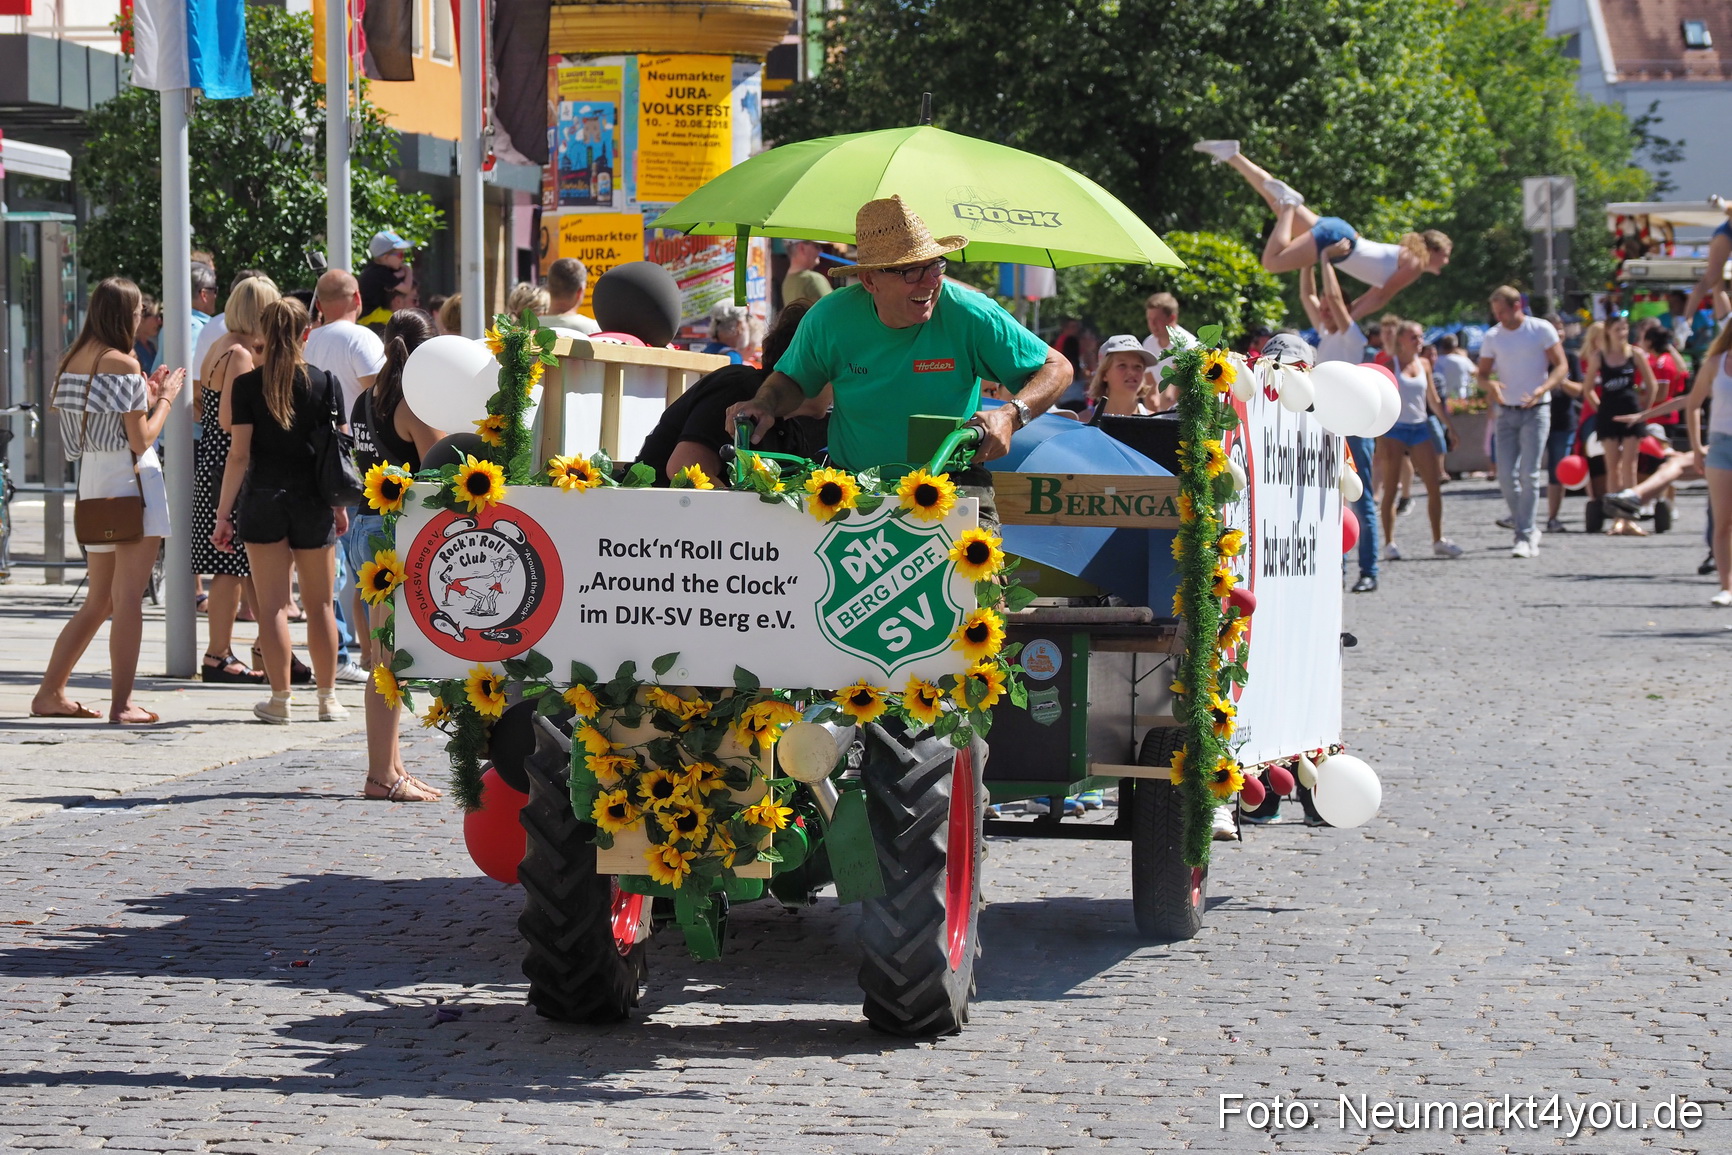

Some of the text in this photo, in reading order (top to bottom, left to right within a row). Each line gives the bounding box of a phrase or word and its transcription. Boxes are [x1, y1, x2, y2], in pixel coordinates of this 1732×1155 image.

[647, 71, 726, 82] Neumarkter
[665, 87, 712, 100] JURA-
[642, 102, 730, 118] VOLKSFEST
[645, 118, 662, 127] 10.
[674, 119, 729, 129] 20.08.2018
[952, 203, 1063, 228] BOCK
[565, 231, 639, 243] Neumarkter
[577, 247, 621, 260] JURA-
[847, 362, 868, 375] Nico
[915, 361, 954, 371] Holder
[353, 427, 371, 441] Roc
[1263, 425, 1276, 485] It's
[1277, 429, 1295, 498] only
[729, 540, 780, 562] Club
[839, 528, 900, 585] DJK
[1263, 518, 1278, 578] but
[1279, 536, 1290, 577] we
[1291, 519, 1307, 577] like
[414, 547, 431, 570] Berg
[459, 551, 487, 568] Club
[413, 571, 429, 611] DJK-SV
[529, 580, 538, 597] the
[681, 573, 719, 594] the
[836, 546, 943, 629] BERG / OPF.
[580, 604, 796, 633] im DJK-SV Berg e.V.
[877, 591, 936, 653] SV
